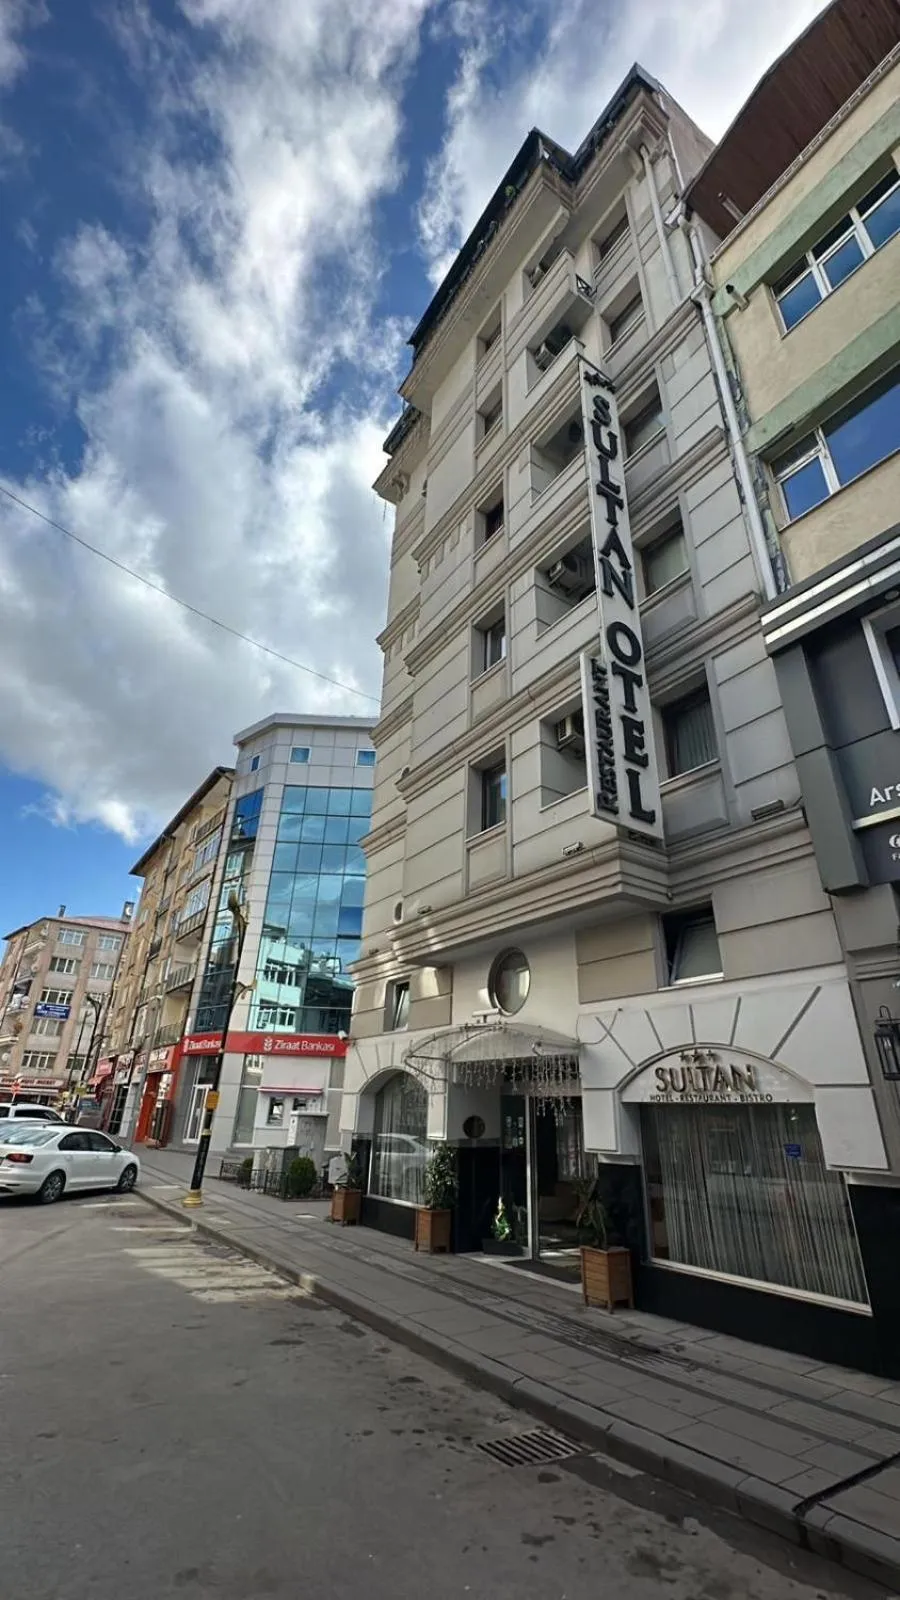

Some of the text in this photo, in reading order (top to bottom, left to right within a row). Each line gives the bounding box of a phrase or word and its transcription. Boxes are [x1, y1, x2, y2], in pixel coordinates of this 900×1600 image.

[590, 394, 656, 825] SULTAN OTEL
[591, 658, 619, 815] RESTAURANT
[274, 1039, 300, 1051] Ziraat
[655, 1064, 756, 1092] SULTAN
[650, 1094, 674, 1102] HOTEL
[740, 1093, 773, 1102] BISTRO
